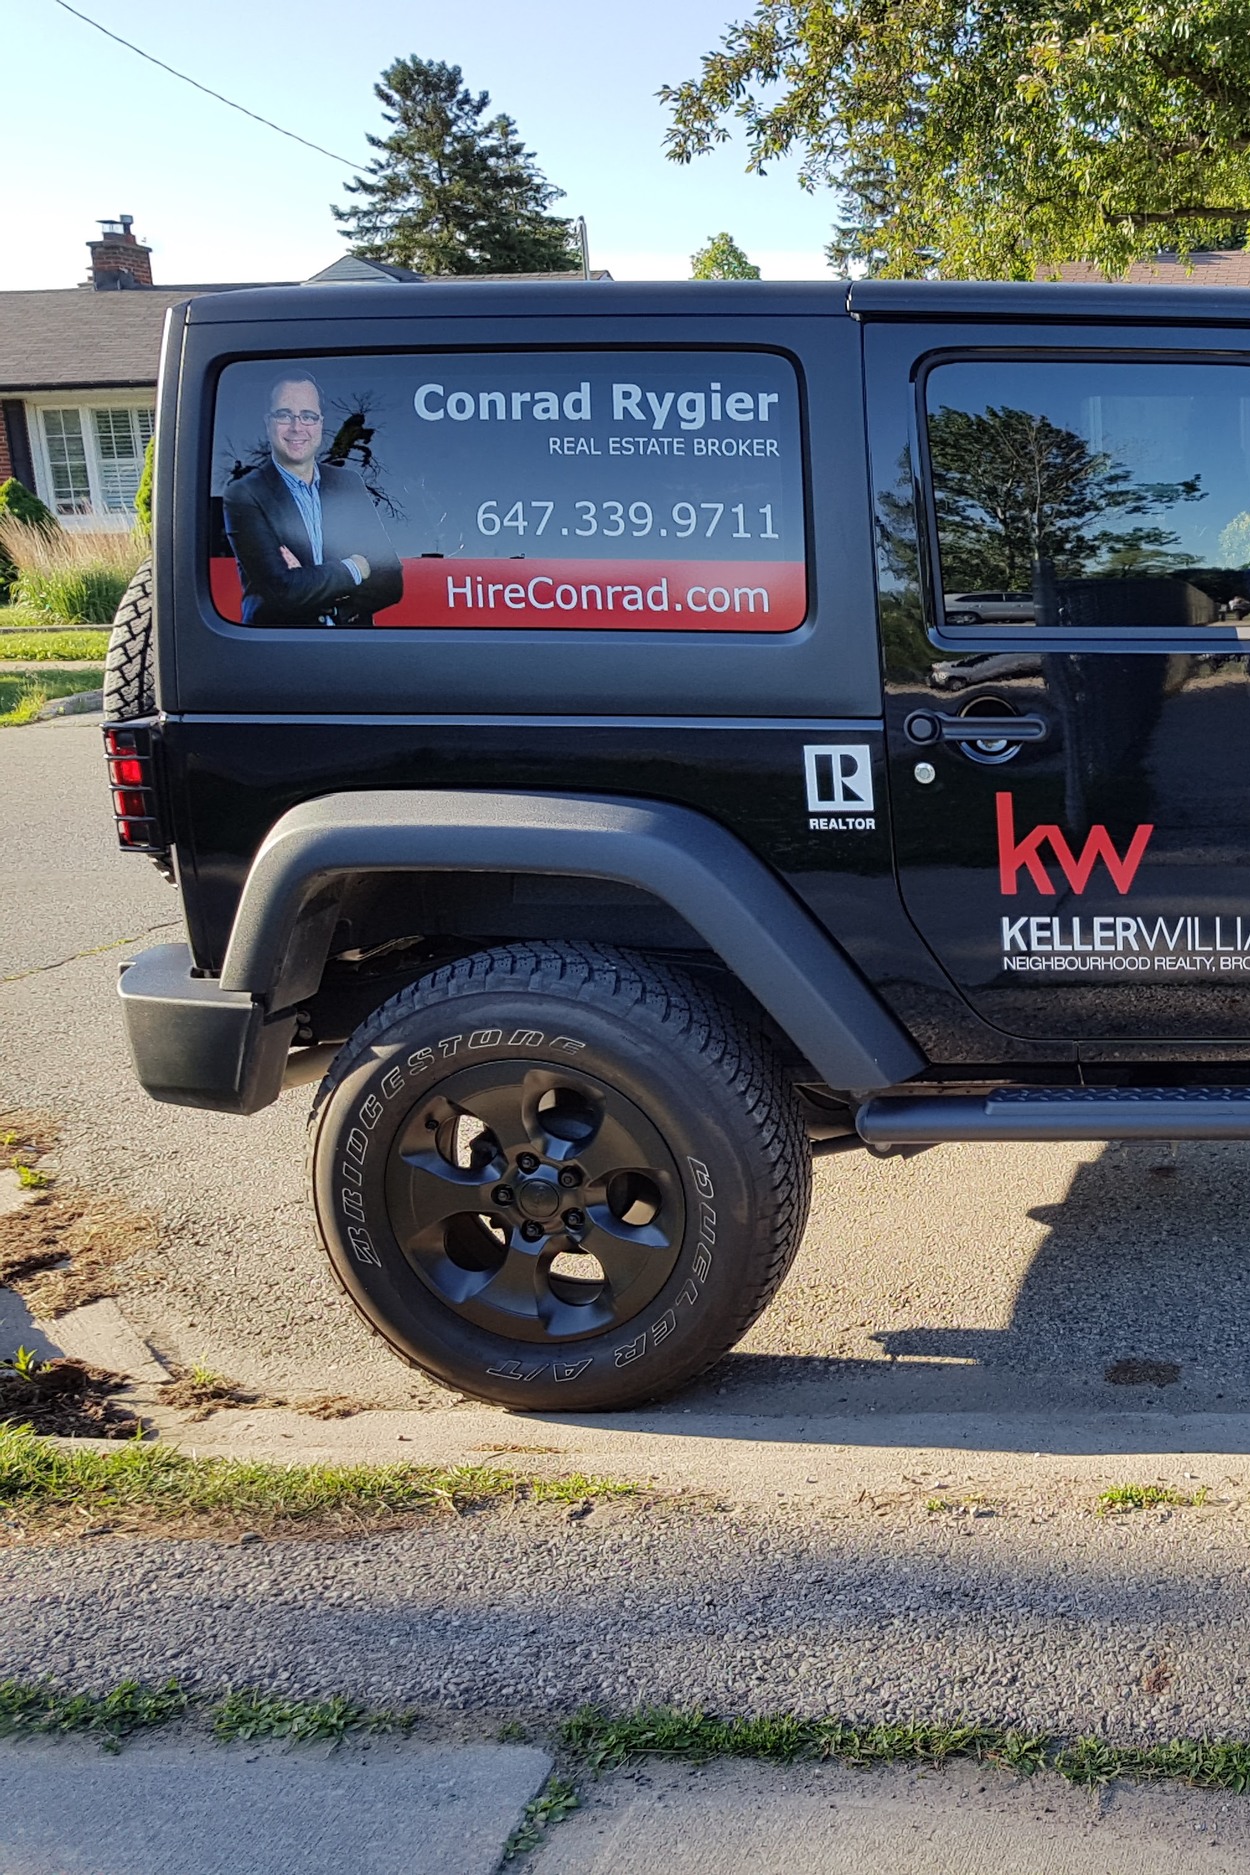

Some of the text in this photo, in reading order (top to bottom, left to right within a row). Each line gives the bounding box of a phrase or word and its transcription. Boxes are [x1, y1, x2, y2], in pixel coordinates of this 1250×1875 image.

[413, 382, 780, 430] Conrad Rygier
[548, 437, 780, 457] REAL ESTATE BROKER
[476, 501, 780, 540] 647.339.9711
[446, 576, 770, 614] HireConrad.com
[809, 818, 876, 830] REALTOR
[996, 792, 1154, 895] kw
[1003, 956, 1151, 971] NEIGHBOURHOOD
[1154, 957, 1217, 973] REALTY,
[341, 1029, 586, 1269] BRIDGESTONE
[613, 1155, 718, 1369] DUELER
